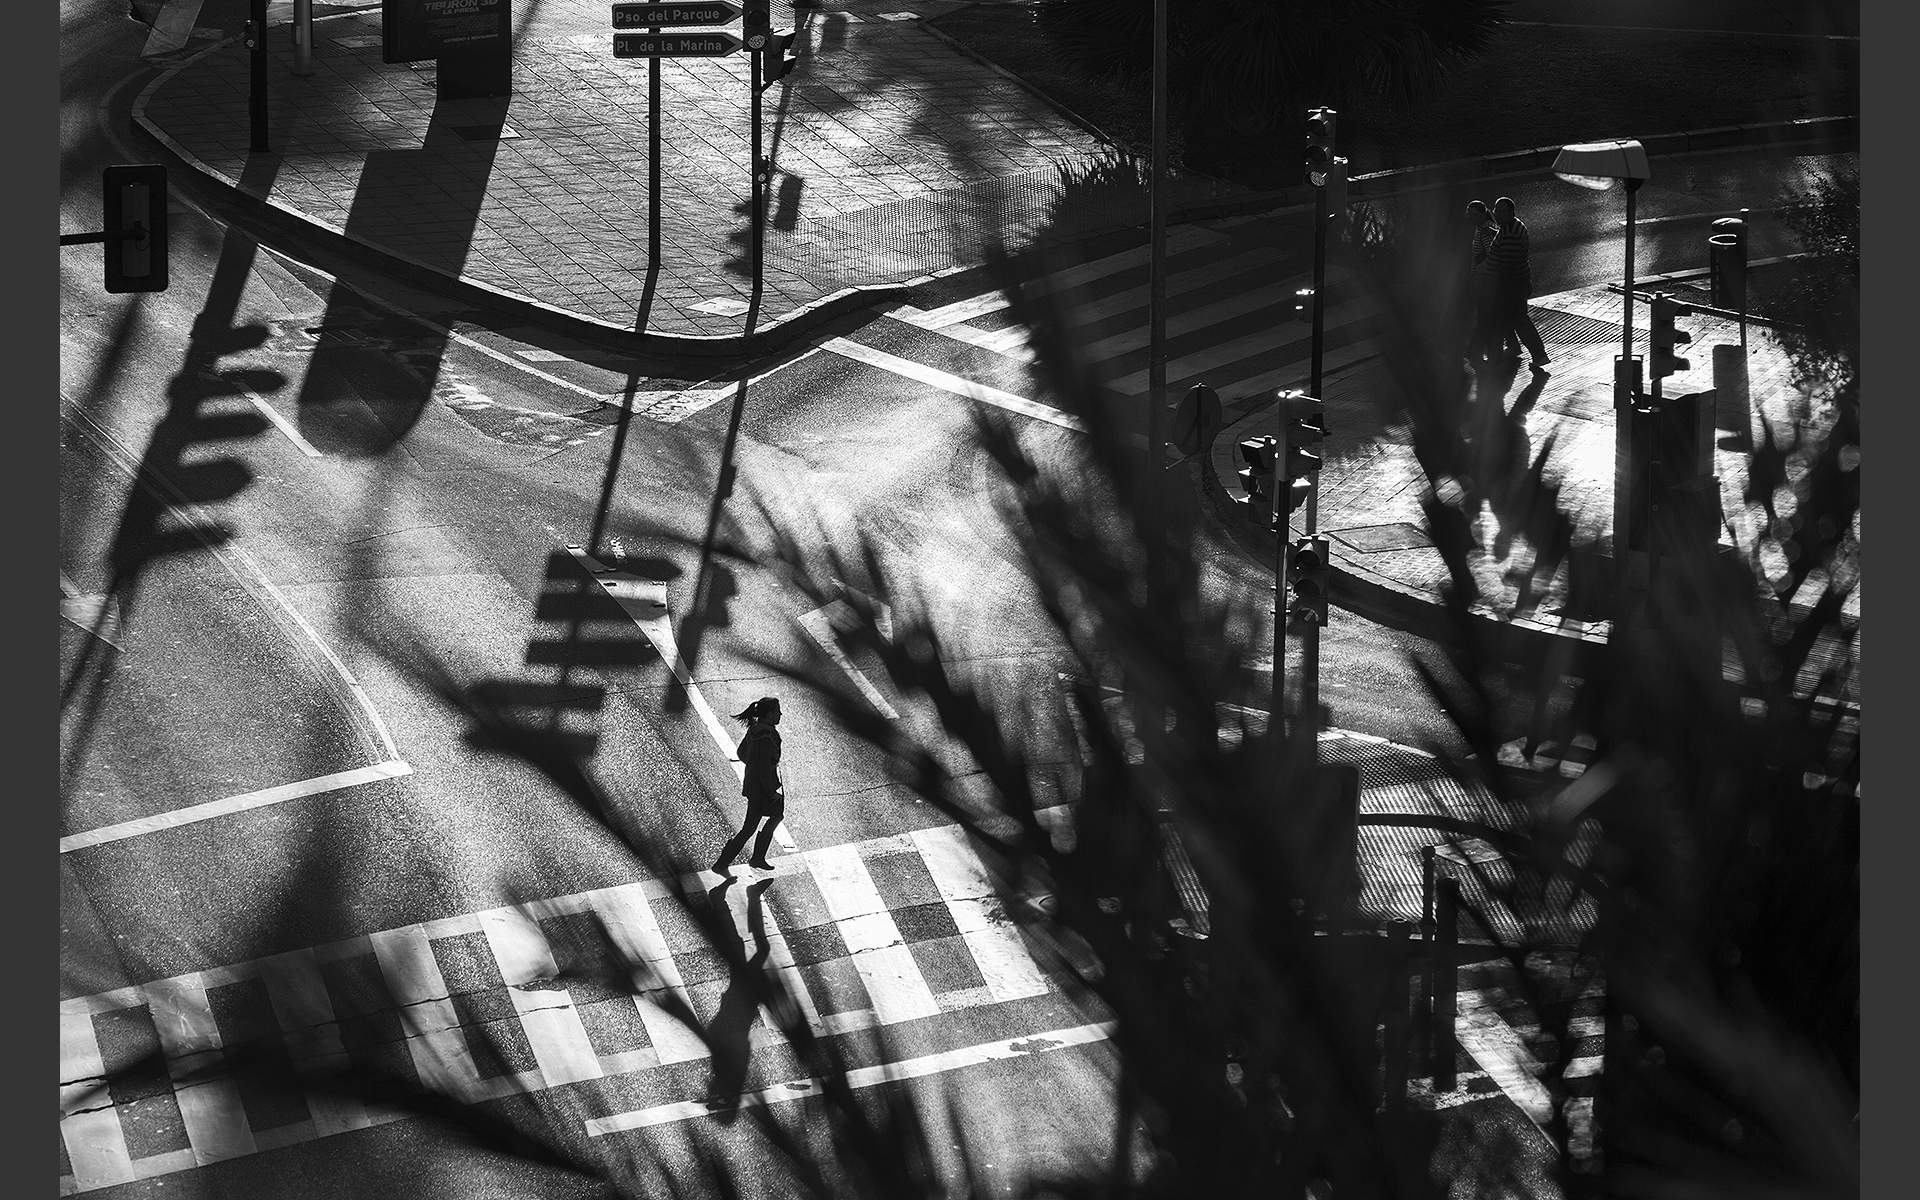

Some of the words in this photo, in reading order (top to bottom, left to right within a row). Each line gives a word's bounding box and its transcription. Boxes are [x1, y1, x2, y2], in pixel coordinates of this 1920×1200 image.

[616, 11, 644, 22] Pso.
[648, 10, 669, 21] del
[673, 9, 720, 21] Parque
[616, 41, 633, 52] Pl.
[640, 41, 655, 51] de
[661, 40, 673, 51] la
[680, 39, 722, 51] Marina
